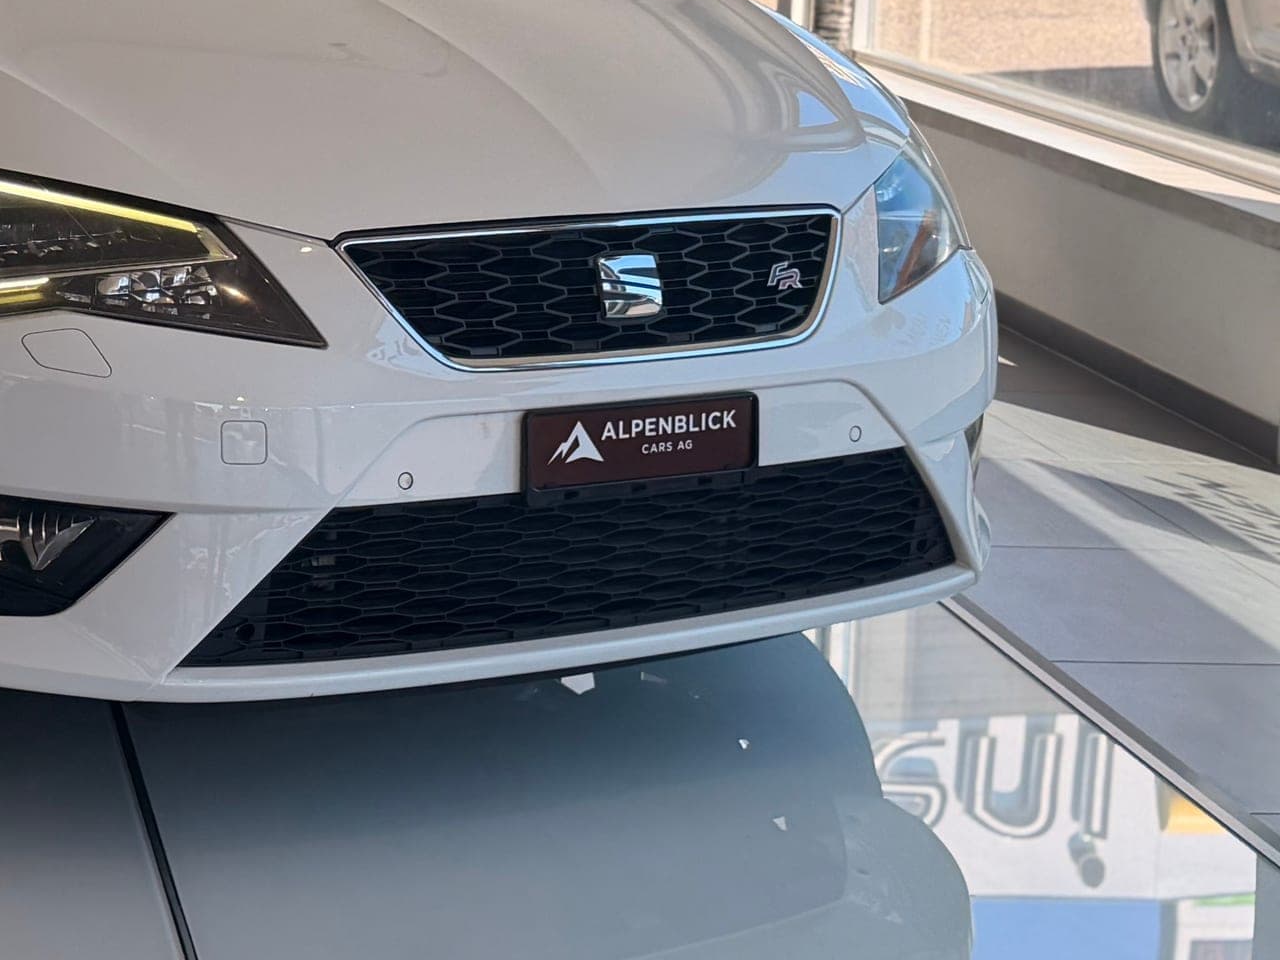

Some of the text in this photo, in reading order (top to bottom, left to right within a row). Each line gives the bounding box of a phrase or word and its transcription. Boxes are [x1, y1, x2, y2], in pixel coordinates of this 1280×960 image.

[600, 409, 738, 442] ALPENBLICK
[641, 439, 694, 455] CARS AG
